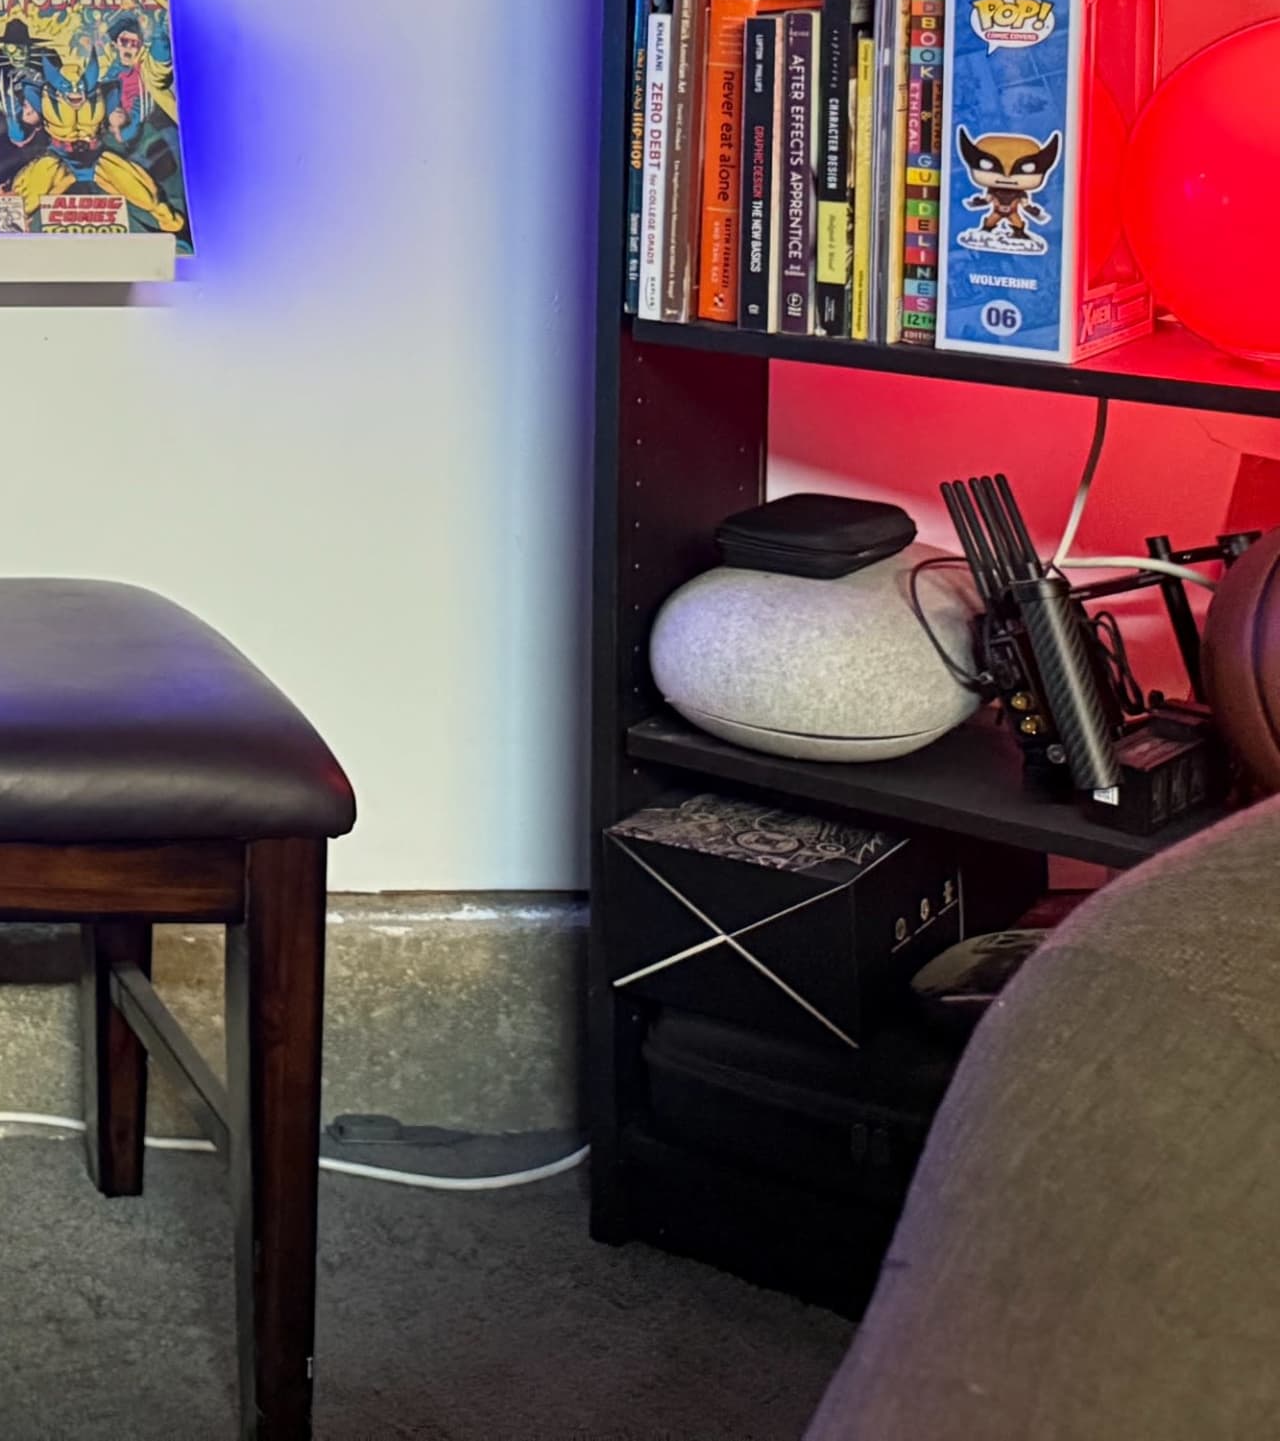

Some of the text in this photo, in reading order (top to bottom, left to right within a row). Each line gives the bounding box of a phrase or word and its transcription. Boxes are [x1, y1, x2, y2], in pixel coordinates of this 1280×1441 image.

[655, 21, 665, 71] KHALFANI
[680, 18, 690, 40] Black
[987, 33, 1009, 41] COMIC
[678, 41, 688, 78] American
[754, 33, 765, 94] LUPTON PHILLIPS
[790, 54, 805, 101] AFTER
[650, 82, 664, 123] ZERO
[677, 80, 687, 93] Art
[717, 70, 737, 202] never eat alone
[789, 105, 805, 167] EFFECTS
[827, 97, 840, 153] CHARACTER
[908, 82, 920, 150] ETHICAL
[648, 129, 662, 170] DEBT
[826, 154, 838, 189] DESIGN
[48, 210, 118, 224] COMES
[646, 189, 657, 231] COLLEGE
[750, 125, 765, 274] GRAPHIC DESIGN THE NEW BASICS
[787, 172, 804, 259] APPRENTICE
[646, 233, 655, 265] GRADS
[916, 155, 932, 311] GUIDELINES
[969, 273, 1038, 291] WOLVERINE
[986, 306, 1017, 328] 06
